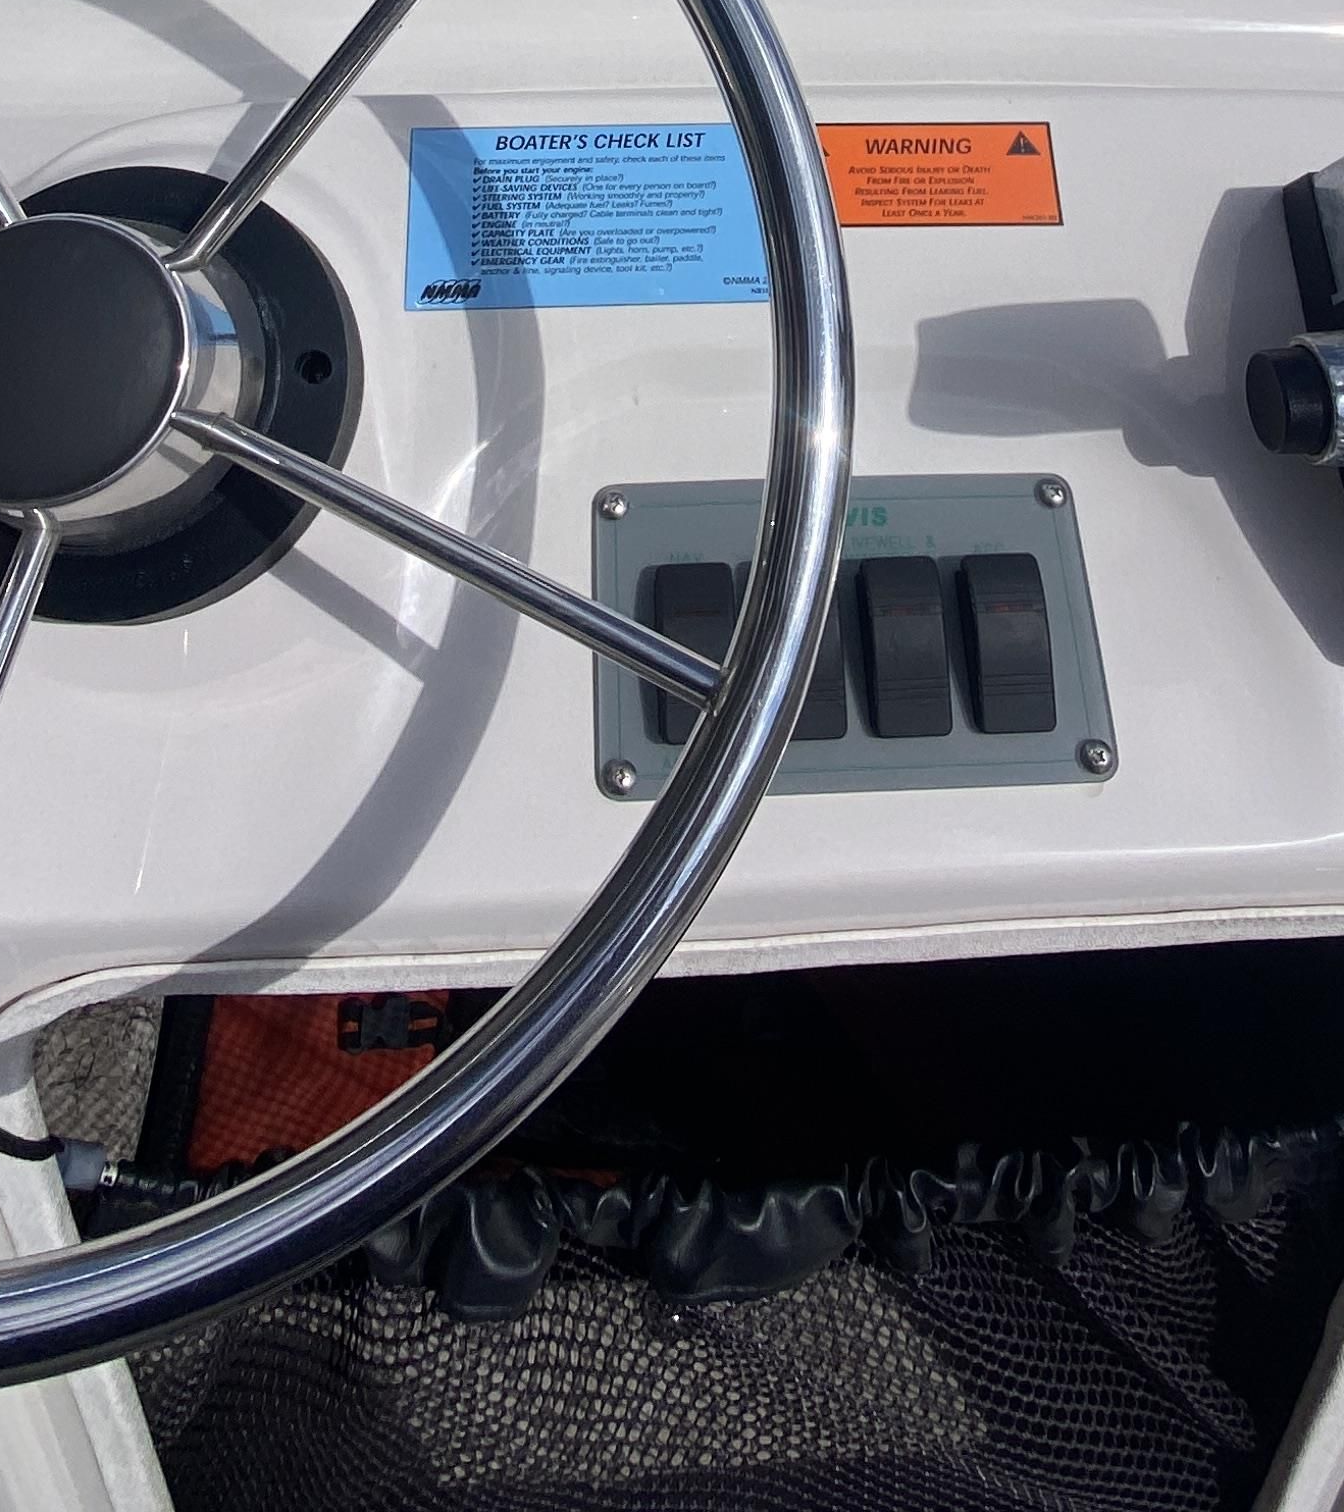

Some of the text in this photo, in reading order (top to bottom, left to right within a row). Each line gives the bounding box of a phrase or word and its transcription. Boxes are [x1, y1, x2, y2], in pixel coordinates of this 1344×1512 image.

[495, 132, 706, 151] BOATER'S CHECK LIST
[865, 137, 972, 155] WARNING
[474, 157, 486, 166] For
[489, 158, 530, 166] maximum
[532, 157, 576, 167] enjoyment
[622, 155, 647, 163] check
[648, 155, 669, 163] each
[681, 155, 702, 163] these
[473, 167, 501, 176] Before
[503, 168, 519, 177] you
[521, 167, 540, 175] start
[542, 167, 561, 176] your
[848, 165, 991, 175] AVOID SERIOUS INJURY OR DEATH
[482, 176, 513, 184] DRAIN
[514, 175, 540, 183] PLUG
[544, 175, 582, 184] (Securely
[866, 175, 975, 185] FROM FIRE OR EXPLOSION
[540, 183, 577, 192] DEVICES
[605, 182, 618, 191] for
[619, 183, 642, 192] every
[643, 182, 671, 191] person
[854, 186, 965, 196] RESULTING FROM LEAKING
[481, 191, 663, 202] STEERING SYSTEM (Working smoothly and
[481, 202, 504, 211] FUEL
[506, 202, 541, 210] SYSTEM
[860, 197, 985, 207] INSPECT SYSTEM FOR LEAKS AT
[481, 211, 521, 220] BATTERY
[589, 210, 614, 218] Cable
[616, 209, 654, 218] terminals
[655, 209, 679, 217] clean
[680, 208, 697, 216] and
[881, 208, 906, 218] LEAST
[908, 208, 933, 218] ONCE
[481, 220, 517, 229] ENGINE
[481, 229, 526, 238] CAPACITY
[527, 229, 554, 237] PLATE
[580, 229, 594, 238] you
[596, 227, 644, 236] overloaded
[481, 238, 526, 247] WEATHER
[527, 237, 589, 246] CONDITIONS
[481, 248, 533, 257] ELECTRICAL
[536, 247, 592, 256] EQUIPMENT
[481, 257, 537, 266] EMERGENCY
[540, 256, 565, 265] GEAR
[616, 264, 633, 273] tool
